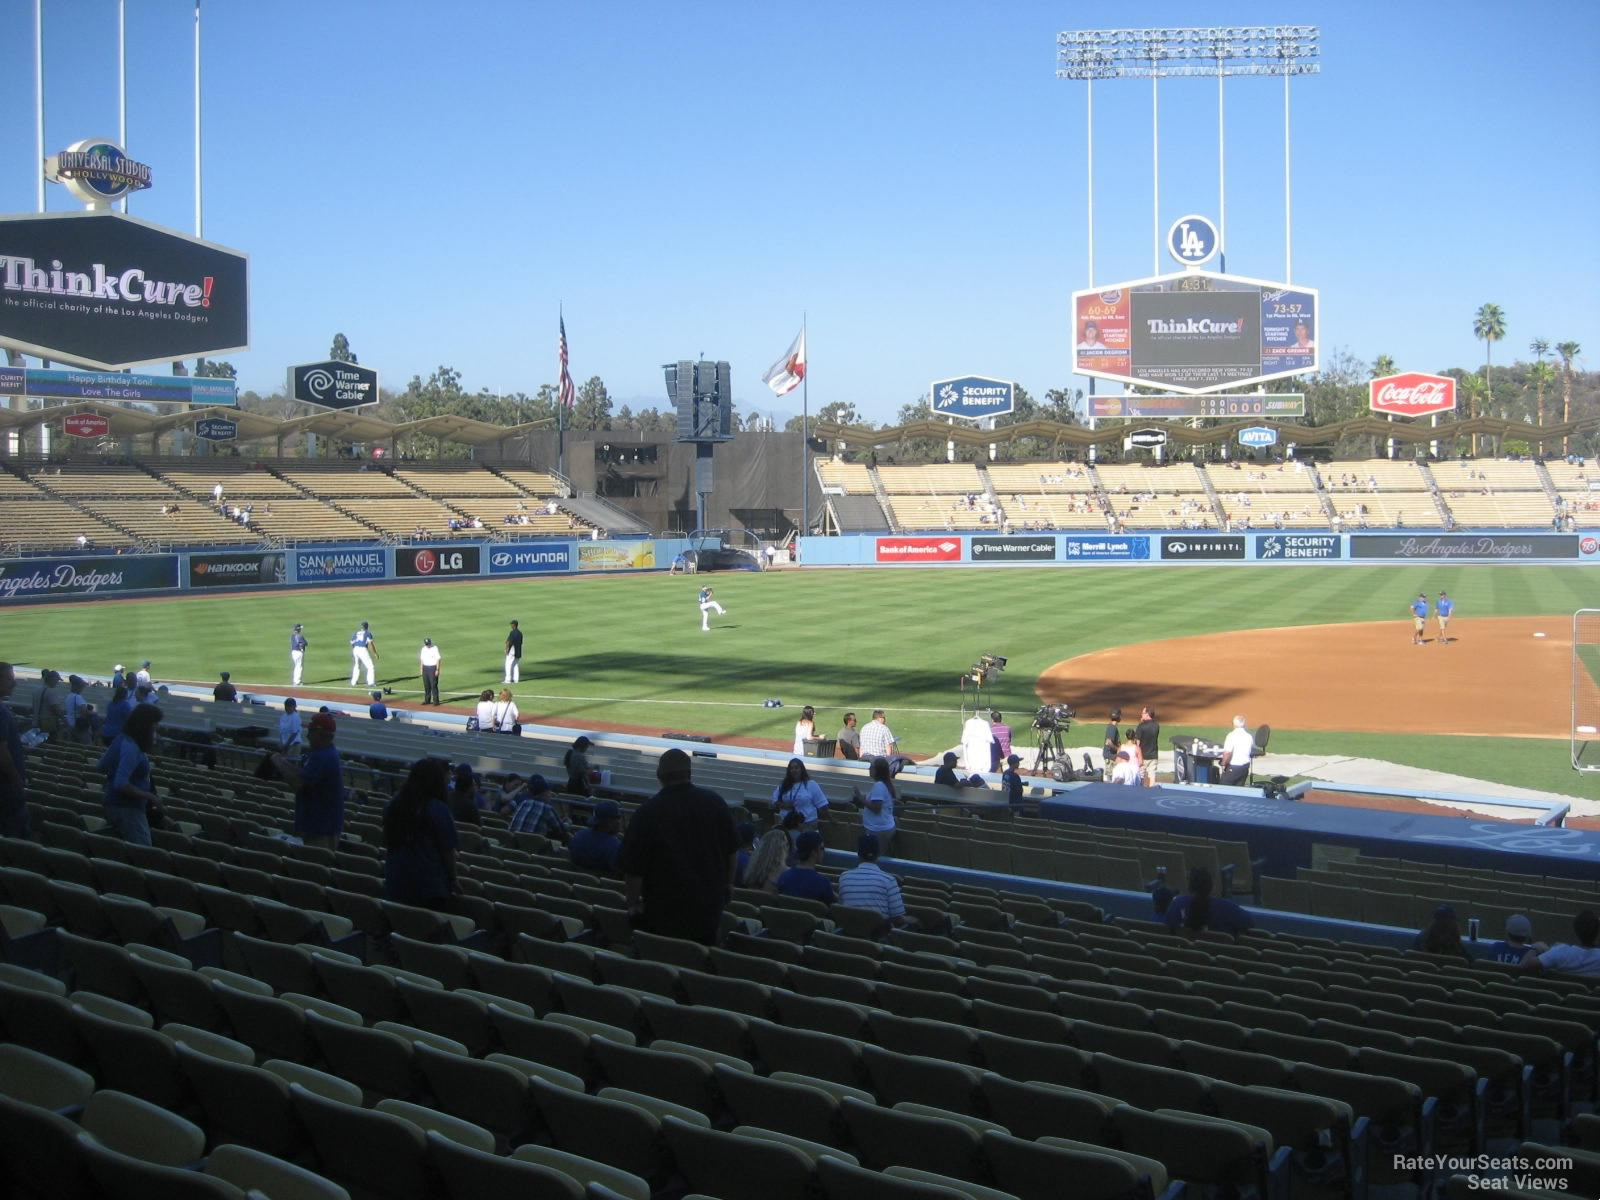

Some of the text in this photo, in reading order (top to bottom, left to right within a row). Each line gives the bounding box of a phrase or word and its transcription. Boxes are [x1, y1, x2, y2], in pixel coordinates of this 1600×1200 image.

[60, 152, 152, 181] UNIVERSAL STUDIOS
[73, 171, 141, 186] HOLLYWOOD
[0, 254, 213, 307] ThinkCure!
[1182, 279, 1208, 290] 4:31
[5, 298, 208, 323] the official charity of the Los Angeles Dodgers
[1088, 306, 1116, 315] 60-69
[1273, 304, 1302, 313] 73-57
[1147, 318, 1244, 334] ThinkCure!
[68, 374, 153, 387] Happy Birthday Toni!
[336, 370, 360, 380] Time
[336, 380, 371, 391] Warner
[962, 386, 1007, 396] SECURITY
[105, 387, 121, 397] The
[122, 389, 141, 398] Girls
[336, 390, 363, 400] Cable
[1377, 382, 1448, 406] Coca-Cola
[962, 396, 1001, 406] BENEFIT
[1266, 401, 1302, 410] SUBWAY
[1230, 402, 1261, 413] 0 0 0
[1242, 432, 1272, 442] AVITA
[1285, 537, 1335, 546] SECURITY
[1031, 544, 1052, 552] Cable
[1107, 543, 1128, 553] Lynch
[1285, 547, 1328, 557] BENEFIT
[1395, 537, 1532, 558] Los Angeles Dodgers
[299, 553, 383, 569] SAN MANUEL
[440, 553, 463, 569] LG
[515, 552, 568, 564] HYUNDAI
[299, 568, 325, 577] INDIAN
[335, 567, 355, 575] BINGO
[361, 566, 384, 574] CASINO
[50, 564, 123, 593] Dodgers
[1411, 824, 1596, 854] Los
